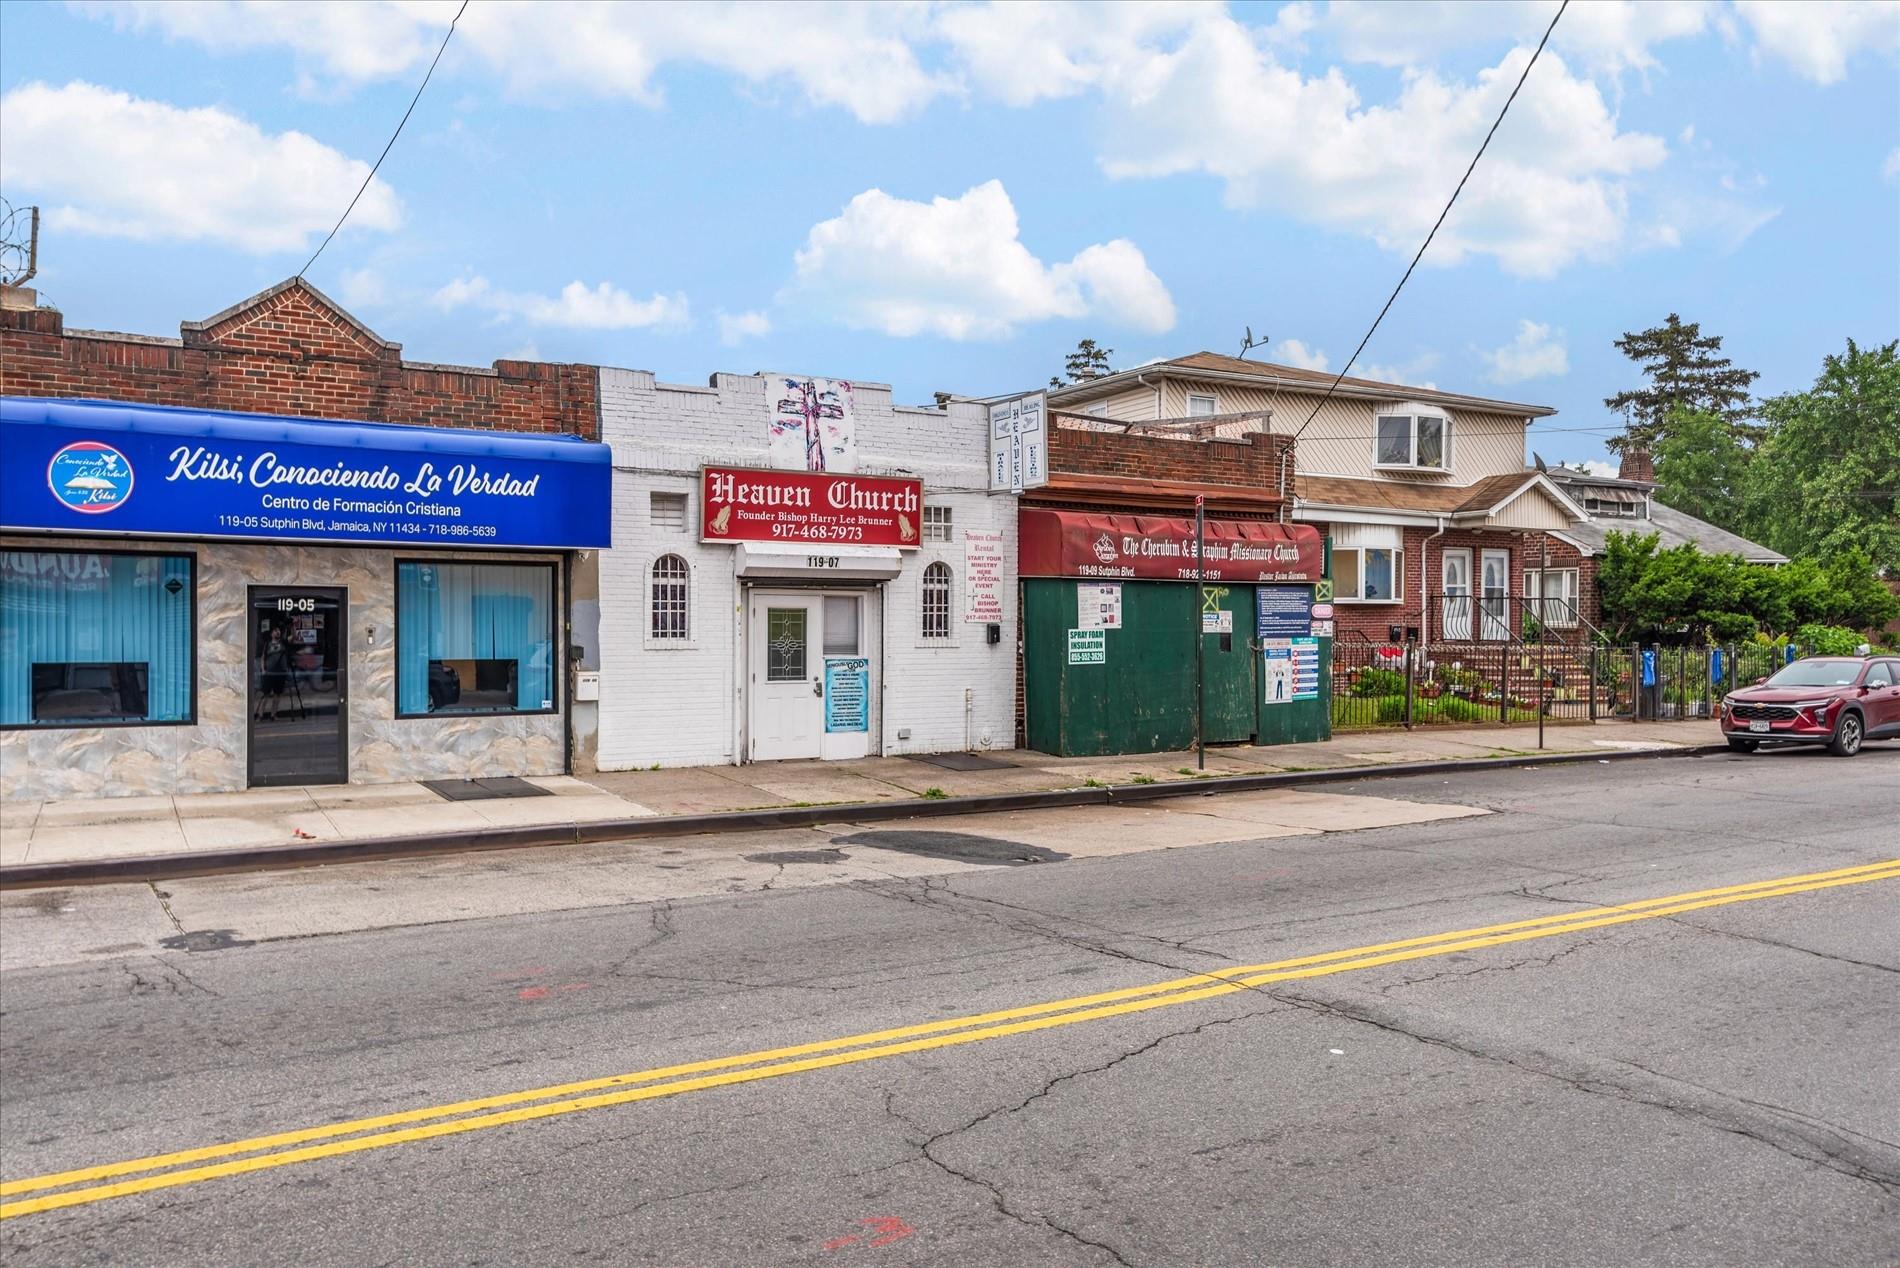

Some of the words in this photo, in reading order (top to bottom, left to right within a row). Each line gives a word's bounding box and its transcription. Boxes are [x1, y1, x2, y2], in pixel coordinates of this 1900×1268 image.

[166, 446, 243, 484] Kilsi,
[249, 452, 400, 490] Conociendo
[404, 462, 442, 497] La
[448, 464, 540, 496] Verdad
[709, 473, 811, 507] Heaven
[828, 480, 918, 512] Church
[262, 494, 310, 510] Centro
[313, 498, 330, 511] de
[333, 498, 402, 514] Formación
[406, 501, 461, 517] Cristiana
[737, 510, 776, 521] Founder
[778, 512, 807, 522] Bishop
[810, 513, 836, 524] Harry
[839, 515, 855, 524] Lee
[858, 516, 893, 526] Brunner
[219, 515, 258, 528] 119-05
[260, 517, 300, 531] Sutphin
[302, 518, 325, 532] Blvd,
[327, 521, 371, 533] Jamaica,
[373, 522, 387, 533] NY
[390, 522, 420, 534] 11434
[429, 524, 496, 536] 718-986-5639
[772, 523, 863, 540] 917-468-7973
[1123, 536, 1139, 558] The
[1141, 538, 1180, 559] Cherubim
[1182, 540, 1190, 557] &
[1191, 540, 1228, 562] Sraphim
[1229, 542, 1272, 564] Missionary
[1273, 544, 1300, 563] Church
[808, 556, 839, 568] 119-07
[1079, 565, 1097, 576] 119-09
[1098, 565, 1120, 577] Sutphin
[1121, 567, 1135, 577] Blvd.
[1178, 568, 1221, 580] 718-92-1151
[278, 598, 315, 611] 119-05
[1070, 631, 1087, 639] SPRAY
[1089, 631, 1103, 639] FOAM
[1071, 641, 1103, 649] INSULATION
[847, 660, 864, 669] GOD
